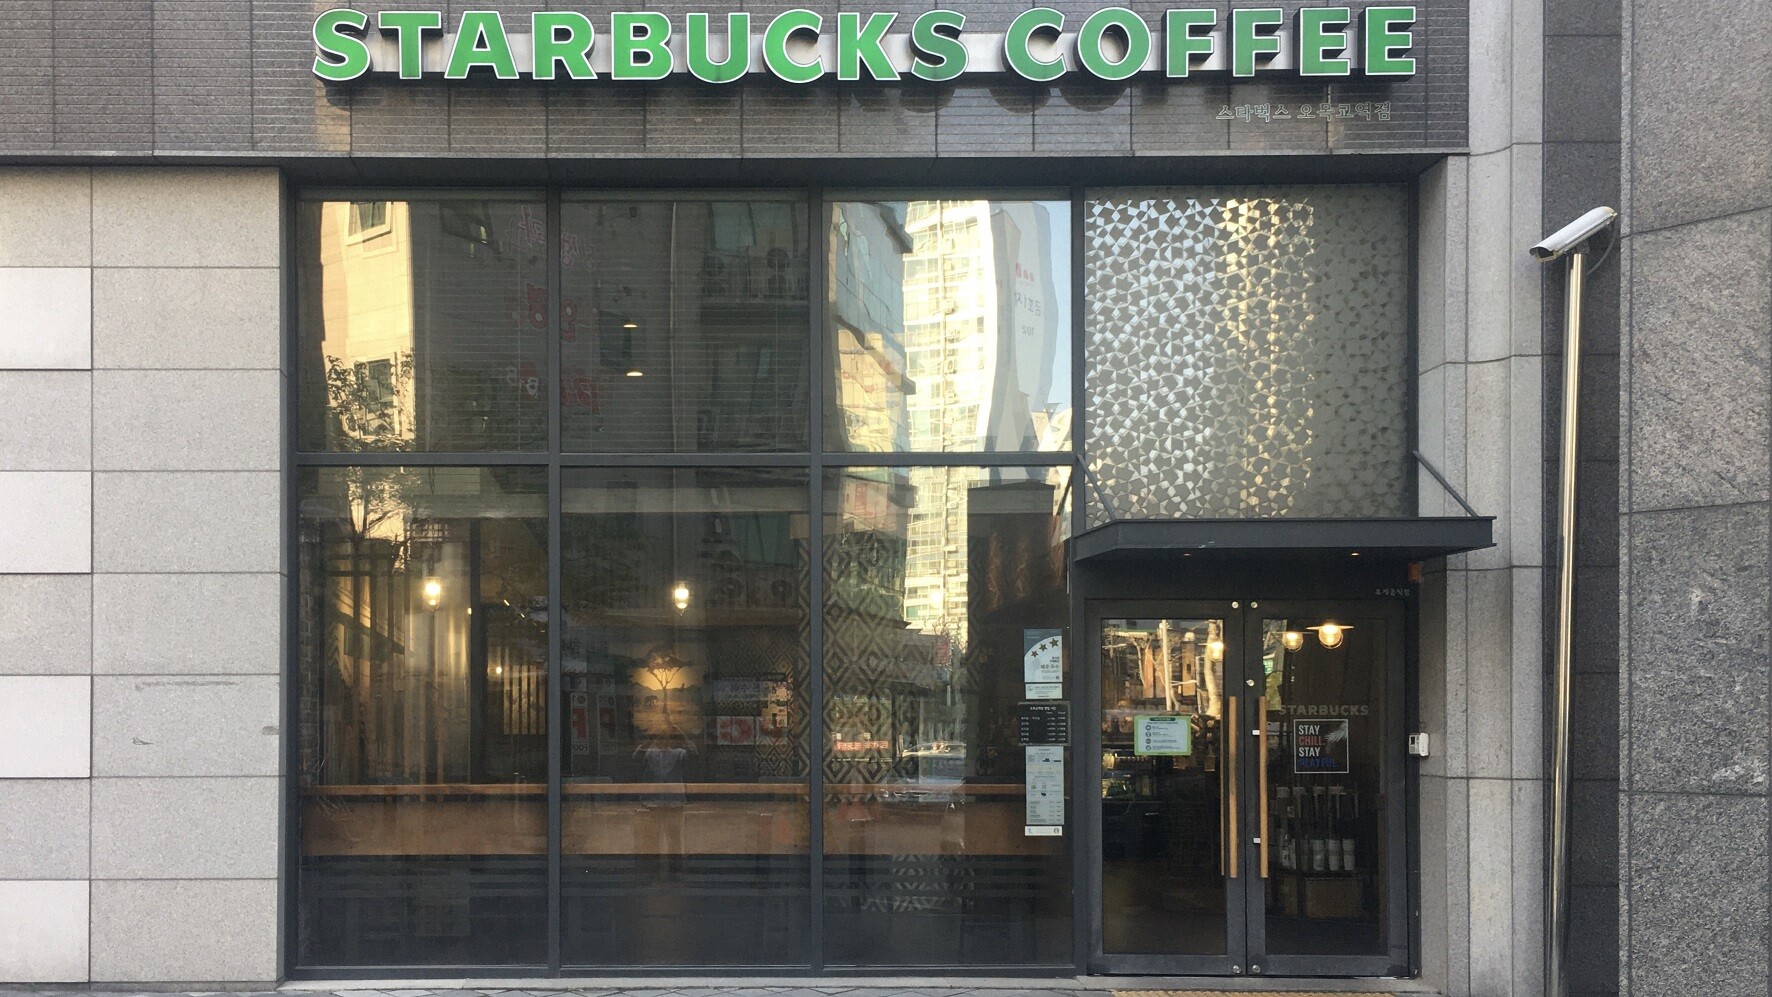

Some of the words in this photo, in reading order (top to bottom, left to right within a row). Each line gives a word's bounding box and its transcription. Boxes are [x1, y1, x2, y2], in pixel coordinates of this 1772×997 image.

[312, 8, 969, 84] STARBUCKS
[1004, 6, 1417, 82] COFFEE
[1215, 102, 1292, 123] 스타벅스
[1297, 101, 1391, 122] 오목교역점
[1279, 704, 1369, 716] STARBUCKS
[1298, 724, 1320, 735] STAY
[1298, 747, 1321, 757] STAY
